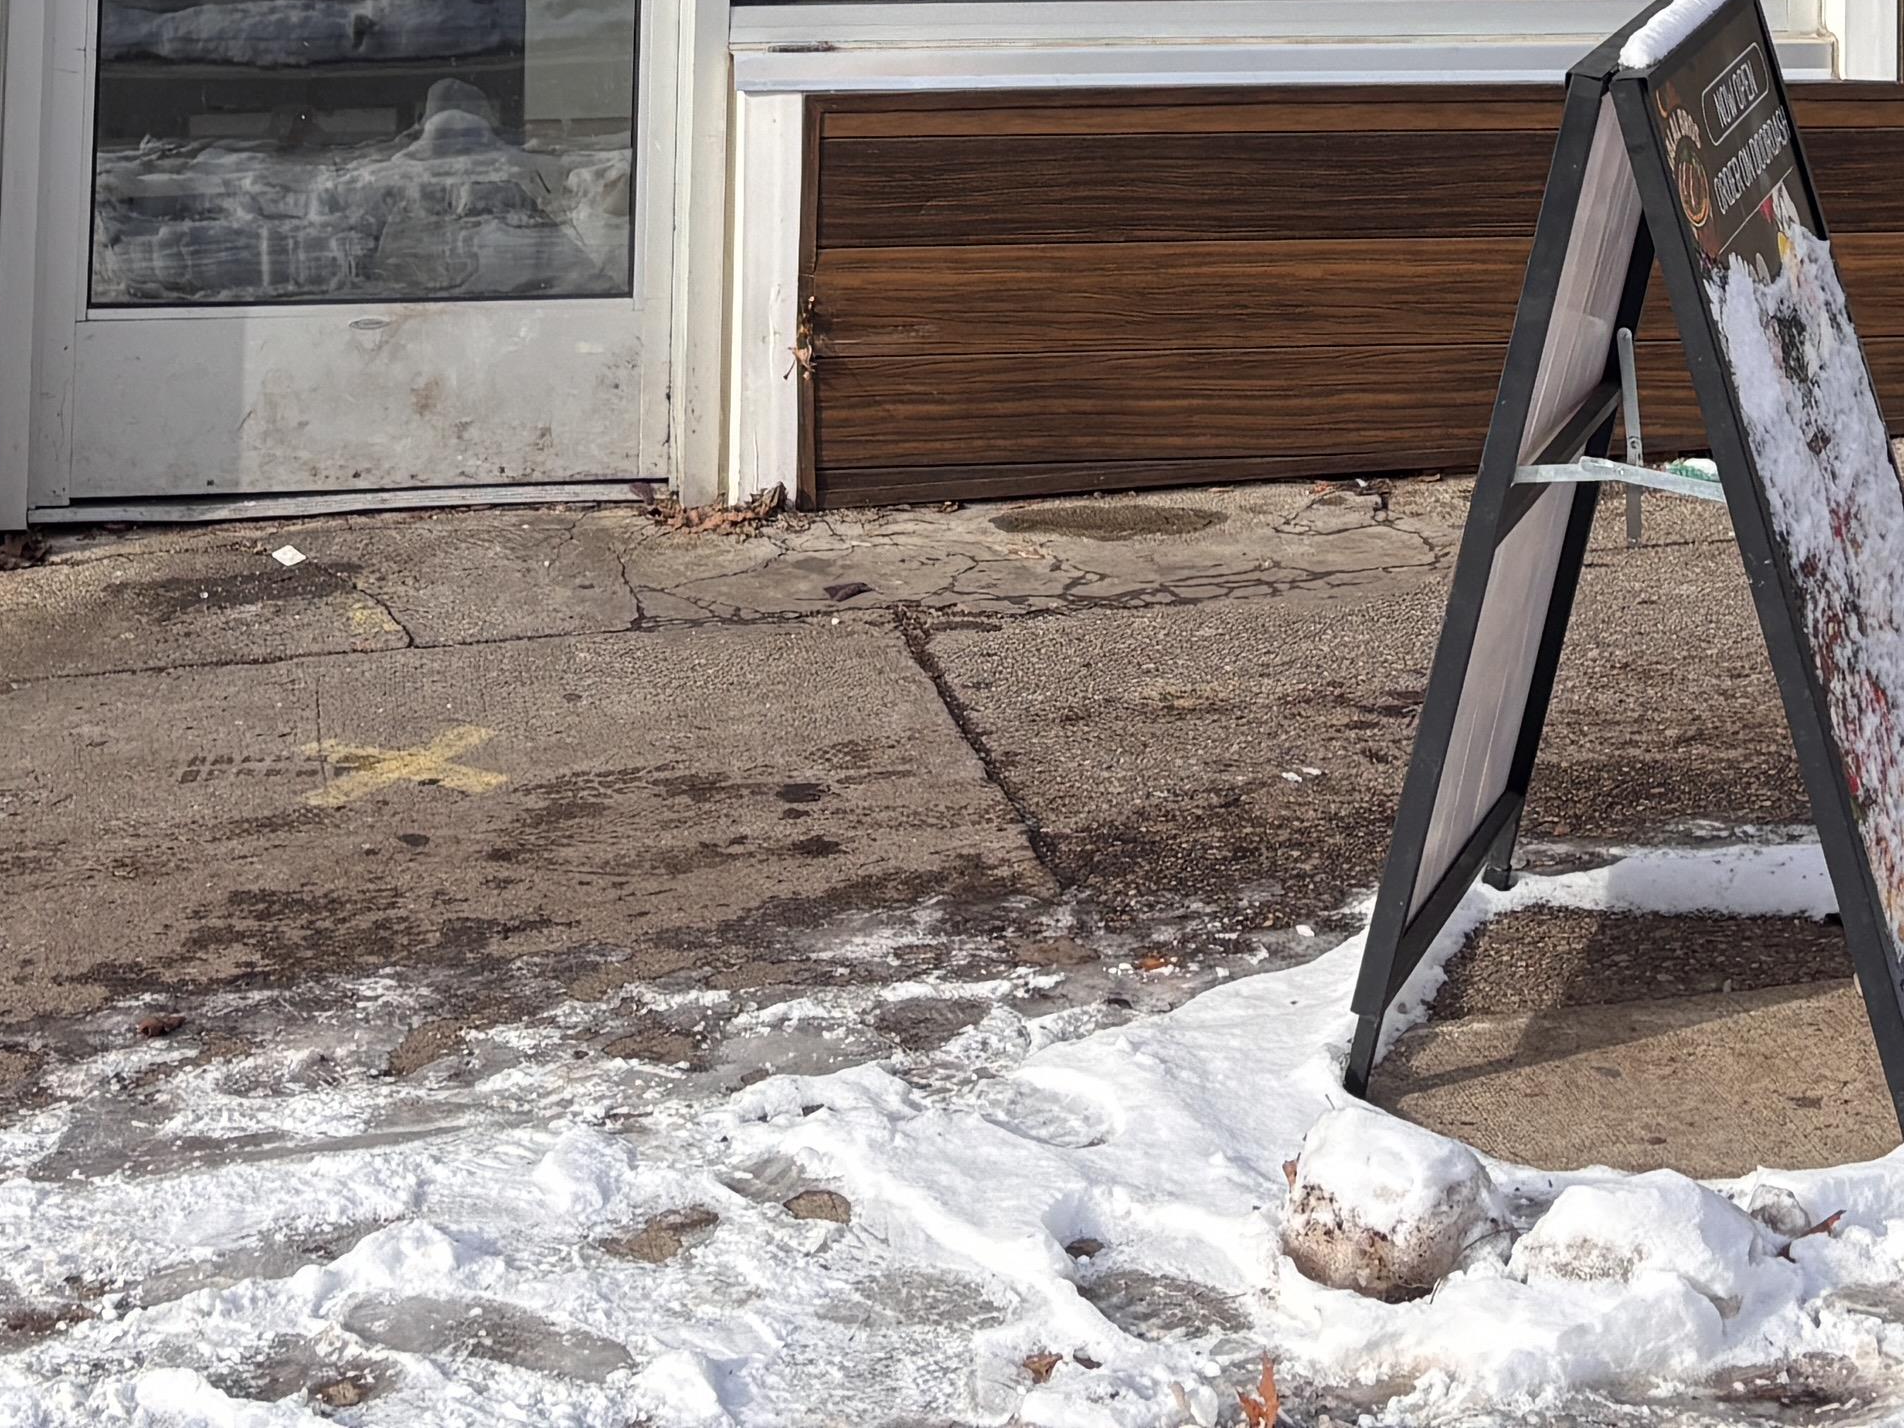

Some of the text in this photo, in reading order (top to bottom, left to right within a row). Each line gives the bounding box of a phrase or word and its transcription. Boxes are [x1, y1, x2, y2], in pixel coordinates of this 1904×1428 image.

[1713, 59, 1759, 129] NOW OPEN
[1714, 104, 1792, 215] ORDER ON DOORDASH
